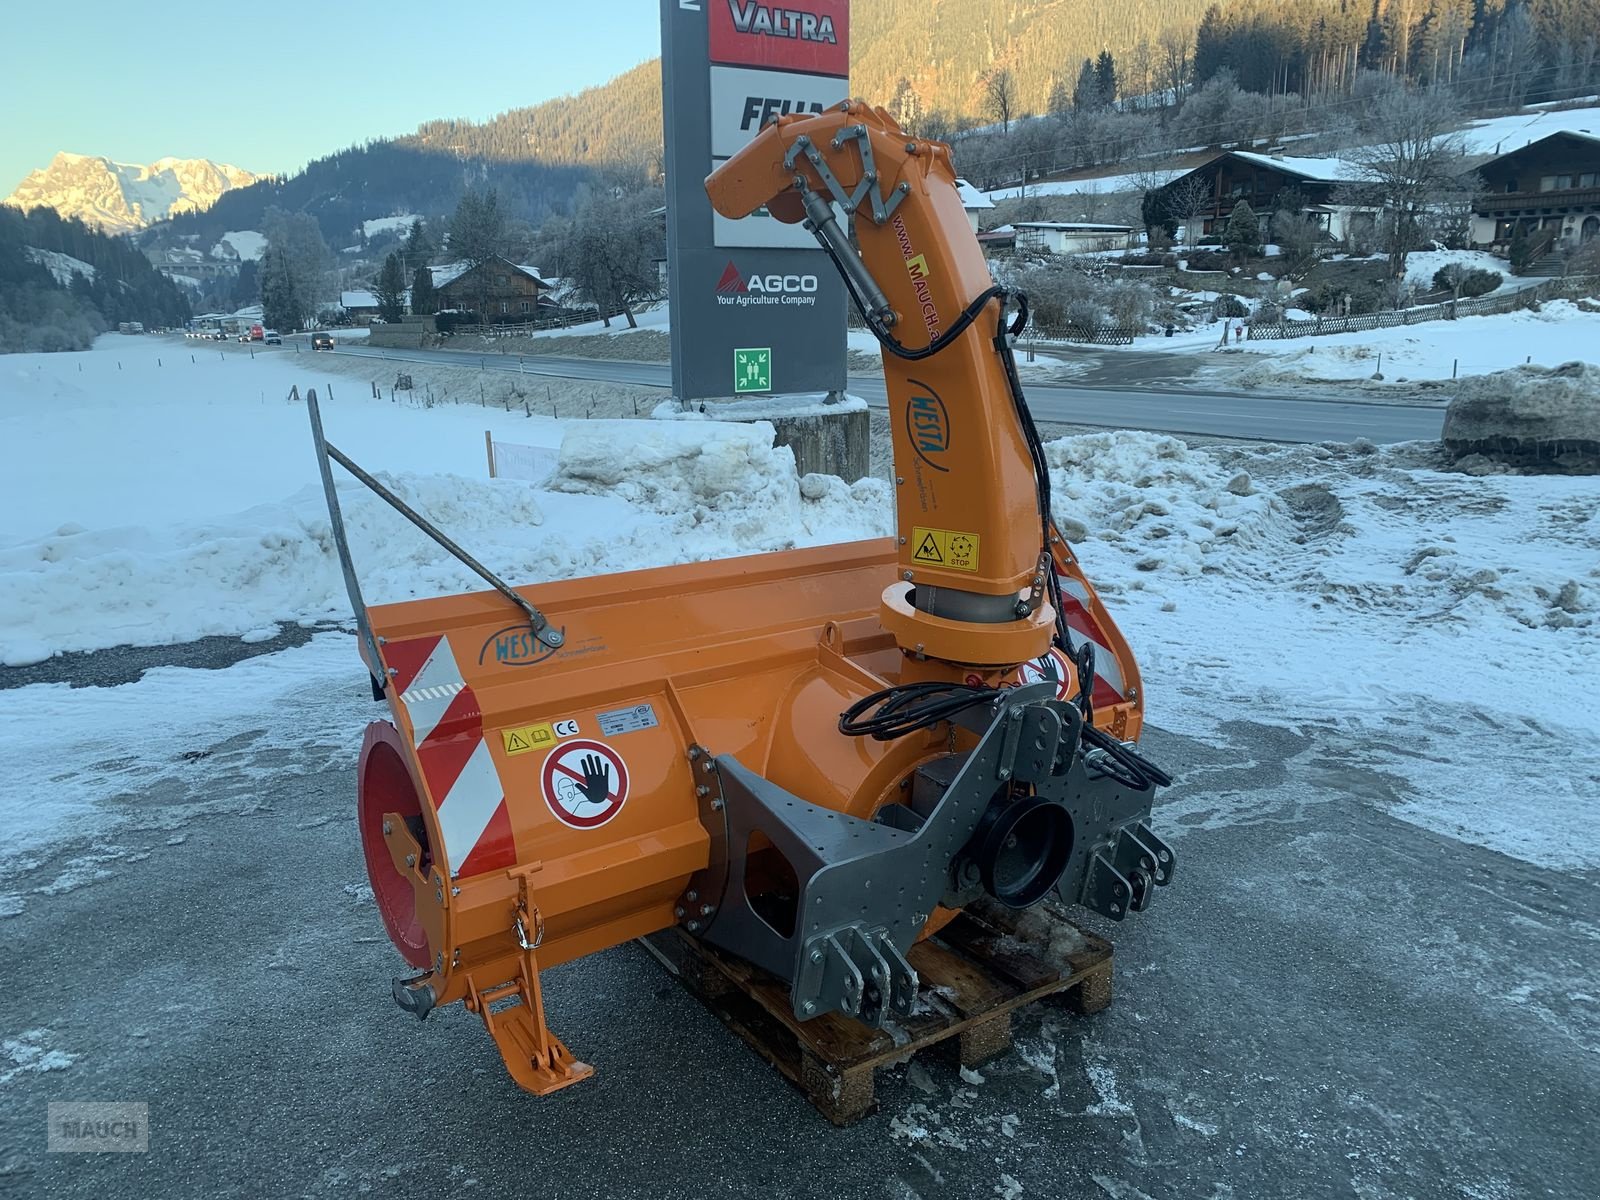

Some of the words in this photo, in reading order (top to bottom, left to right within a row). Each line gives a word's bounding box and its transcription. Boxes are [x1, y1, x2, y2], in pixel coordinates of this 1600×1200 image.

[728, 0, 837, 44] VALTRA
[747, 275, 818, 292] AGCO
[717, 295, 735, 305] Your
[736, 295, 779, 307] Agriculture
[781, 295, 816, 306] Company
[911, 397, 945, 452] WESTA
[951, 559, 970, 567] STOP
